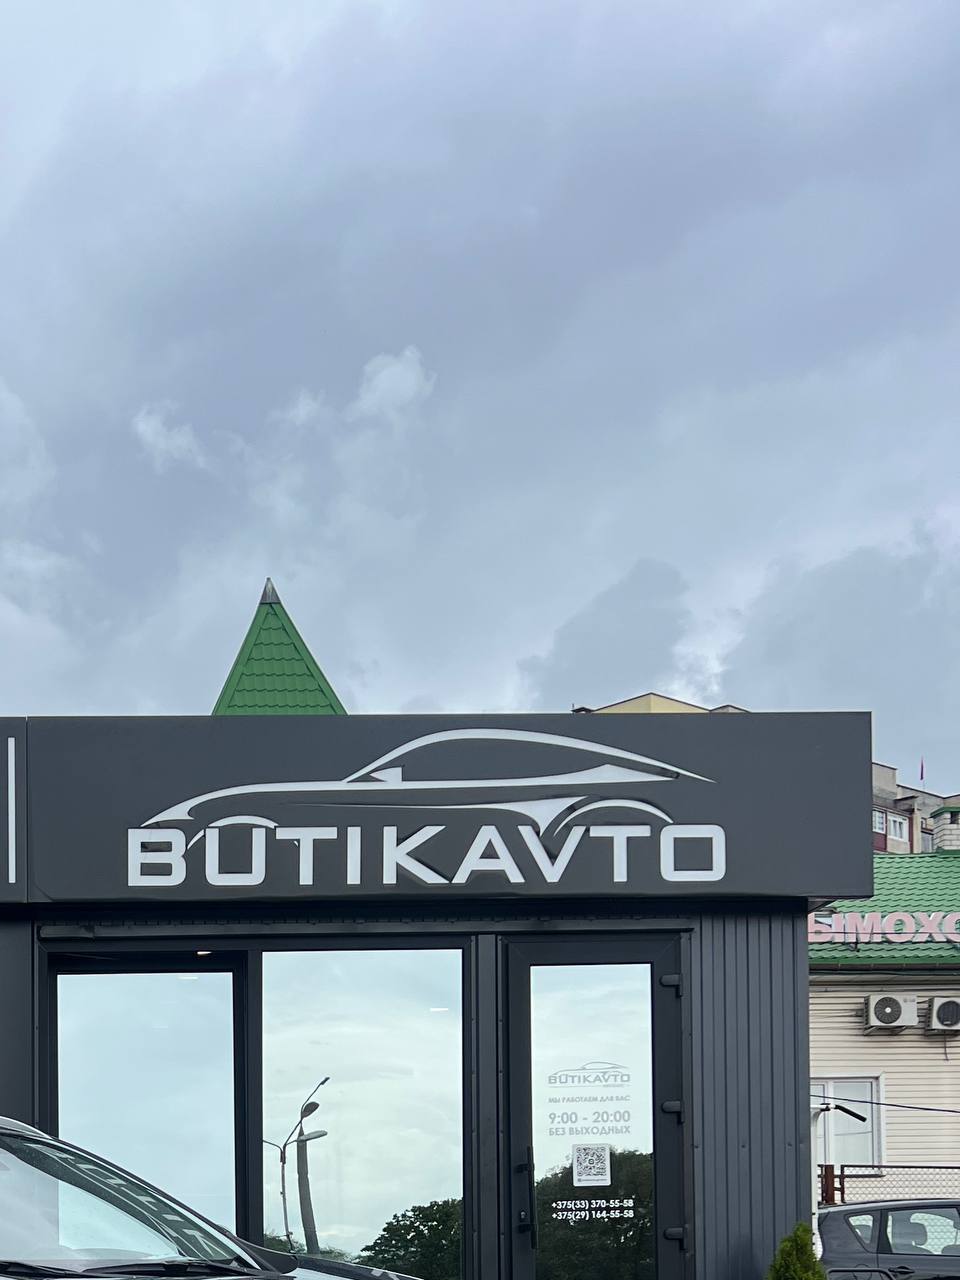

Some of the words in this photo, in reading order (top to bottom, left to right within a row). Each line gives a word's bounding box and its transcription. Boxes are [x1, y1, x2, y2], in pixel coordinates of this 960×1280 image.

[127, 824, 726, 887] BUTIKAVTO
[548, 1074, 630, 1084] BUTIKAVTO
[615, 1094, 631, 1102] ВАС
[548, 1112, 578, 1124] 9:00
[592, 1110, 631, 1123] 20:00
[548, 1127, 566, 1136] БЕЗ
[569, 1126, 631, 1136] ВЫХОДНЫХ
[551, 1200, 589, 1210] +375(33)
[591, 1199, 634, 1208] 370-55-58
[551, 1210, 589, 1221] +375(29)
[591, 1209, 635, 1219] 164-55-58
